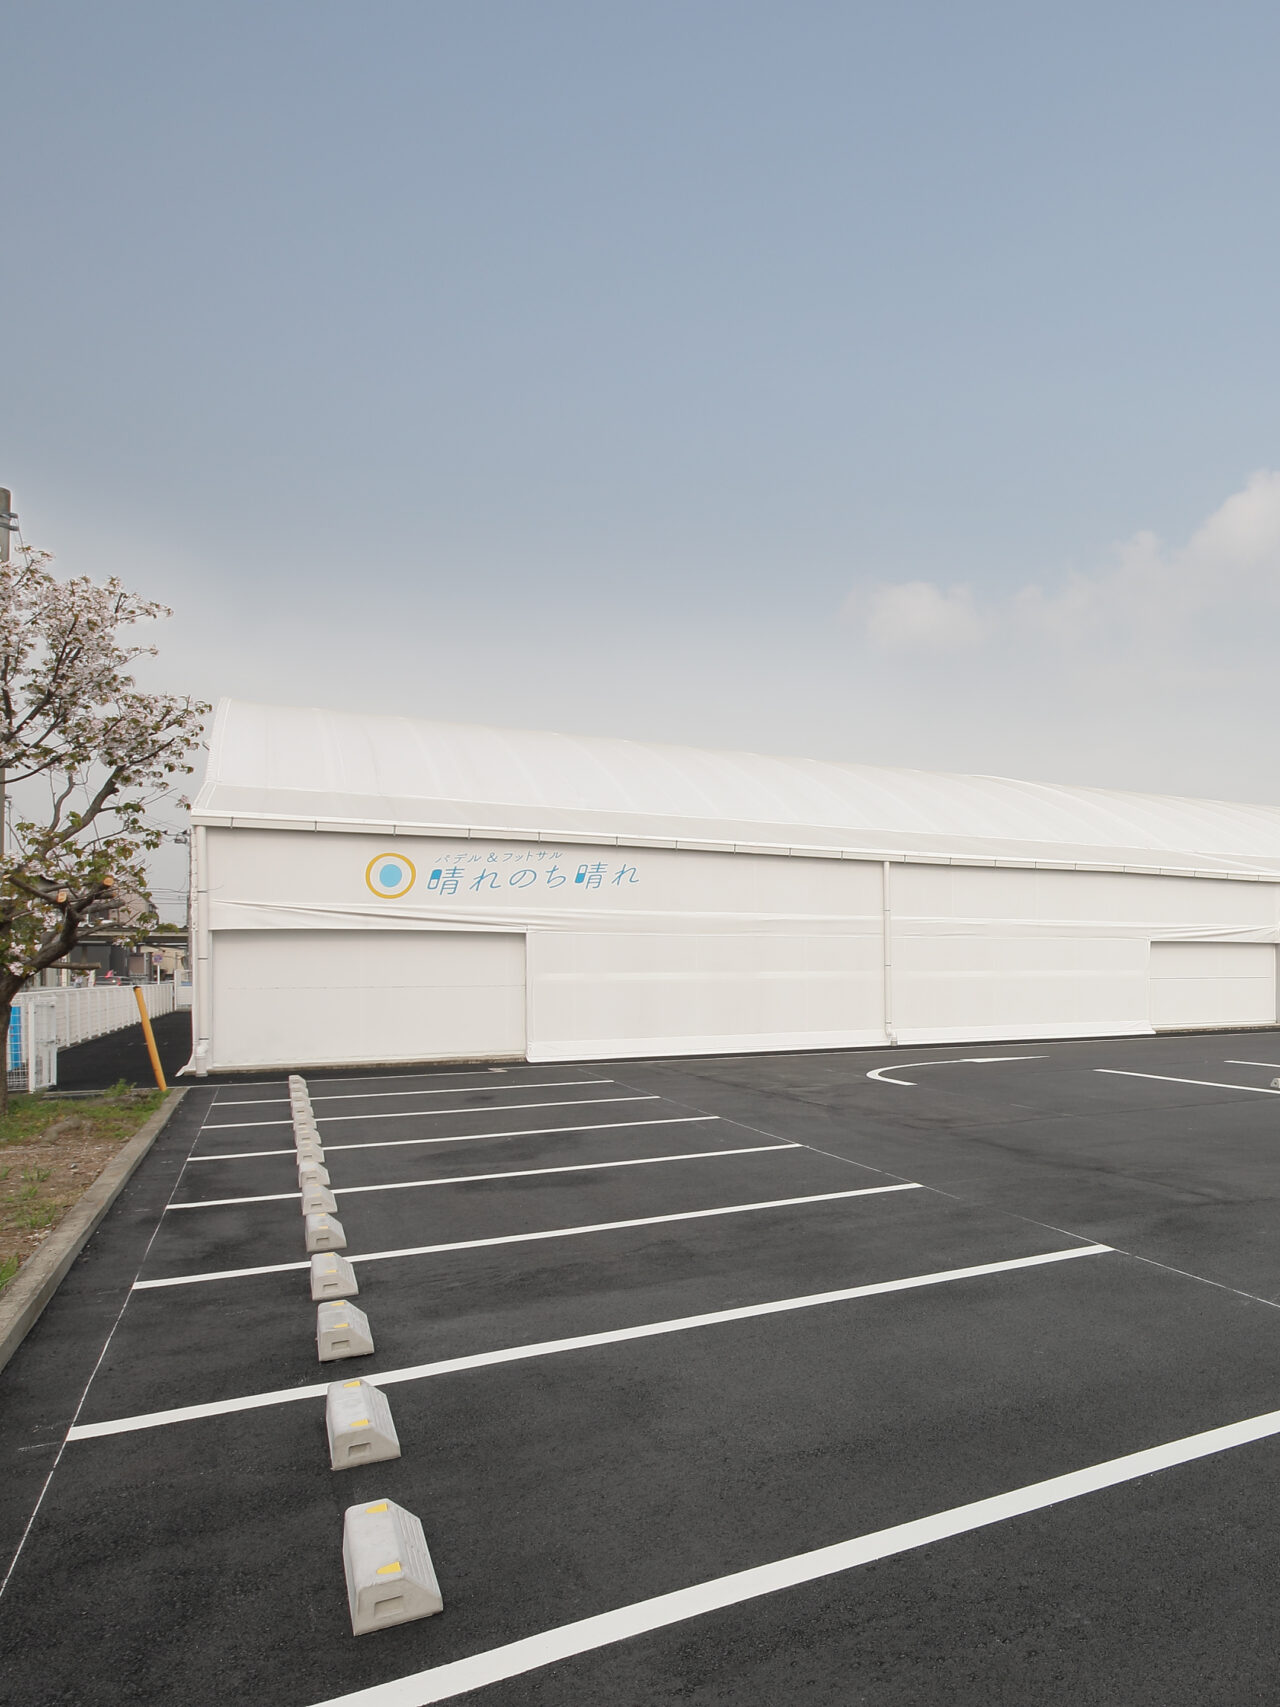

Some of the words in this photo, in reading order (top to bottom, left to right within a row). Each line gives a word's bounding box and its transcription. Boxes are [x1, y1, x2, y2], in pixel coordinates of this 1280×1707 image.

[427, 861, 640, 895] 晴れのち晴れ
